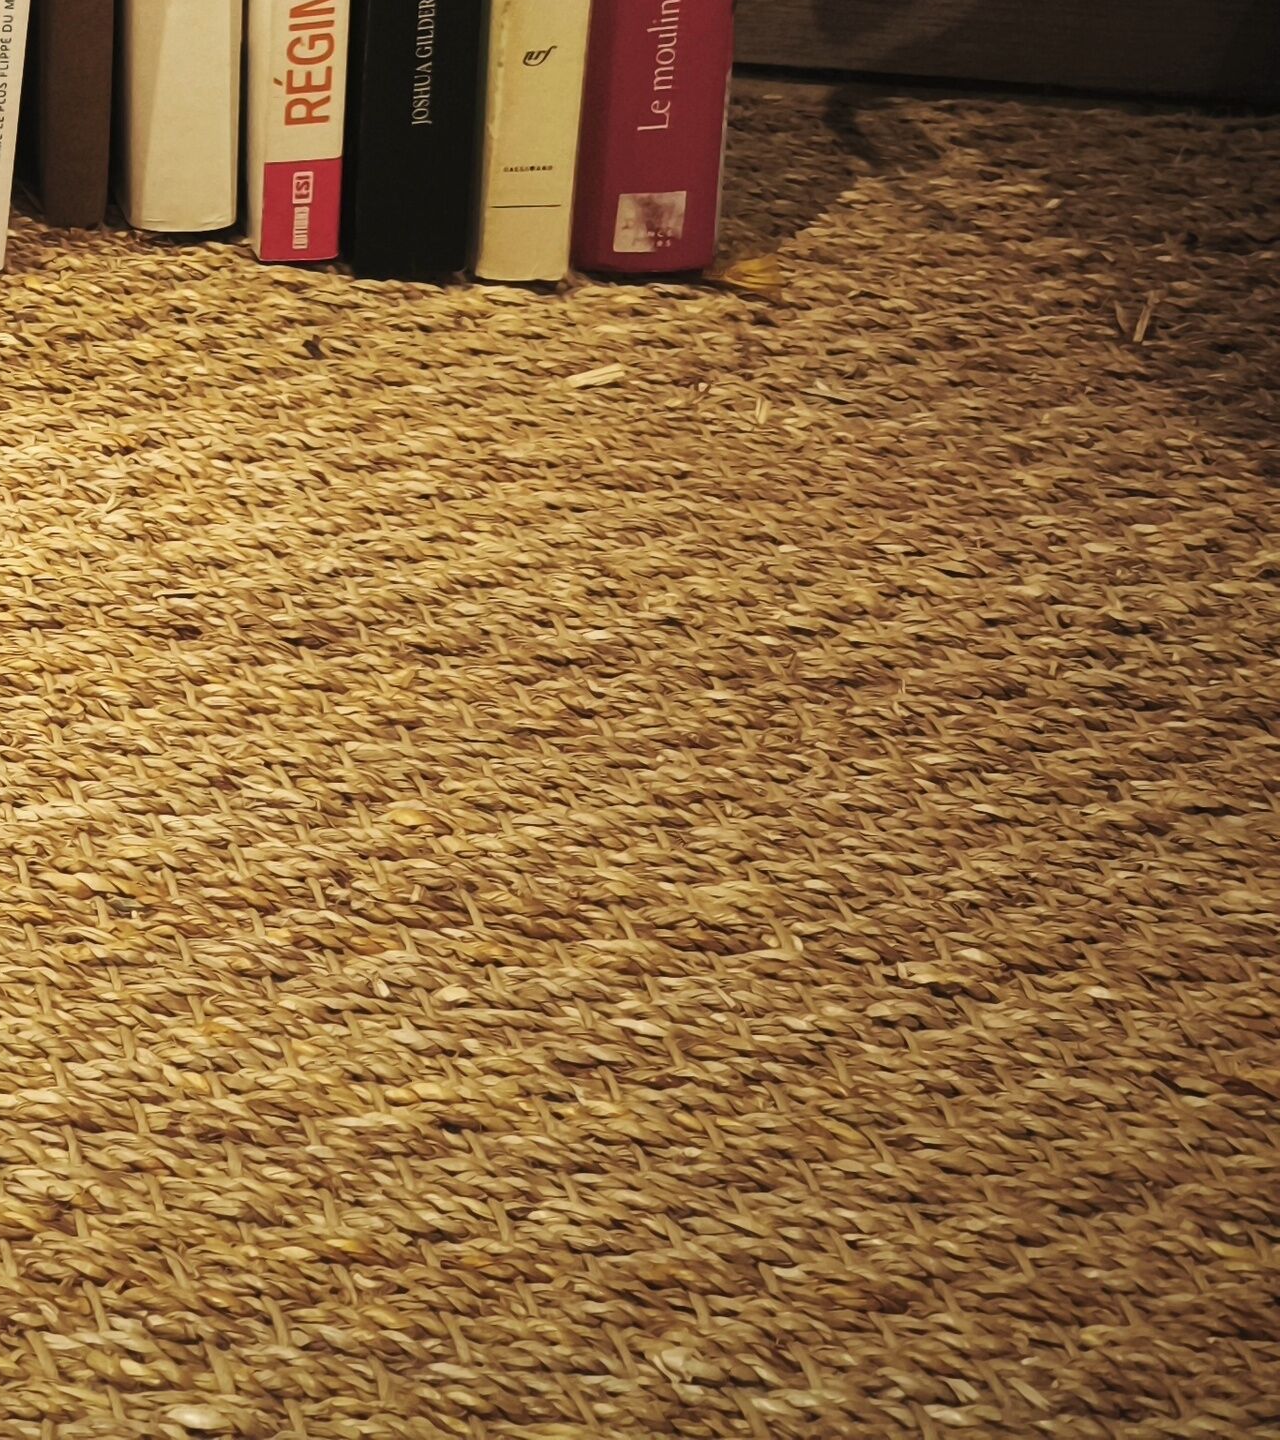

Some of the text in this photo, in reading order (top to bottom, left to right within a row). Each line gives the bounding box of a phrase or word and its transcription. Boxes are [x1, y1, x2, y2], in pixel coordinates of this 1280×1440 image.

[2, 13, 14, 34] DU
[412, 60, 433, 126] JOSHUA
[637, 101, 671, 133] Le
